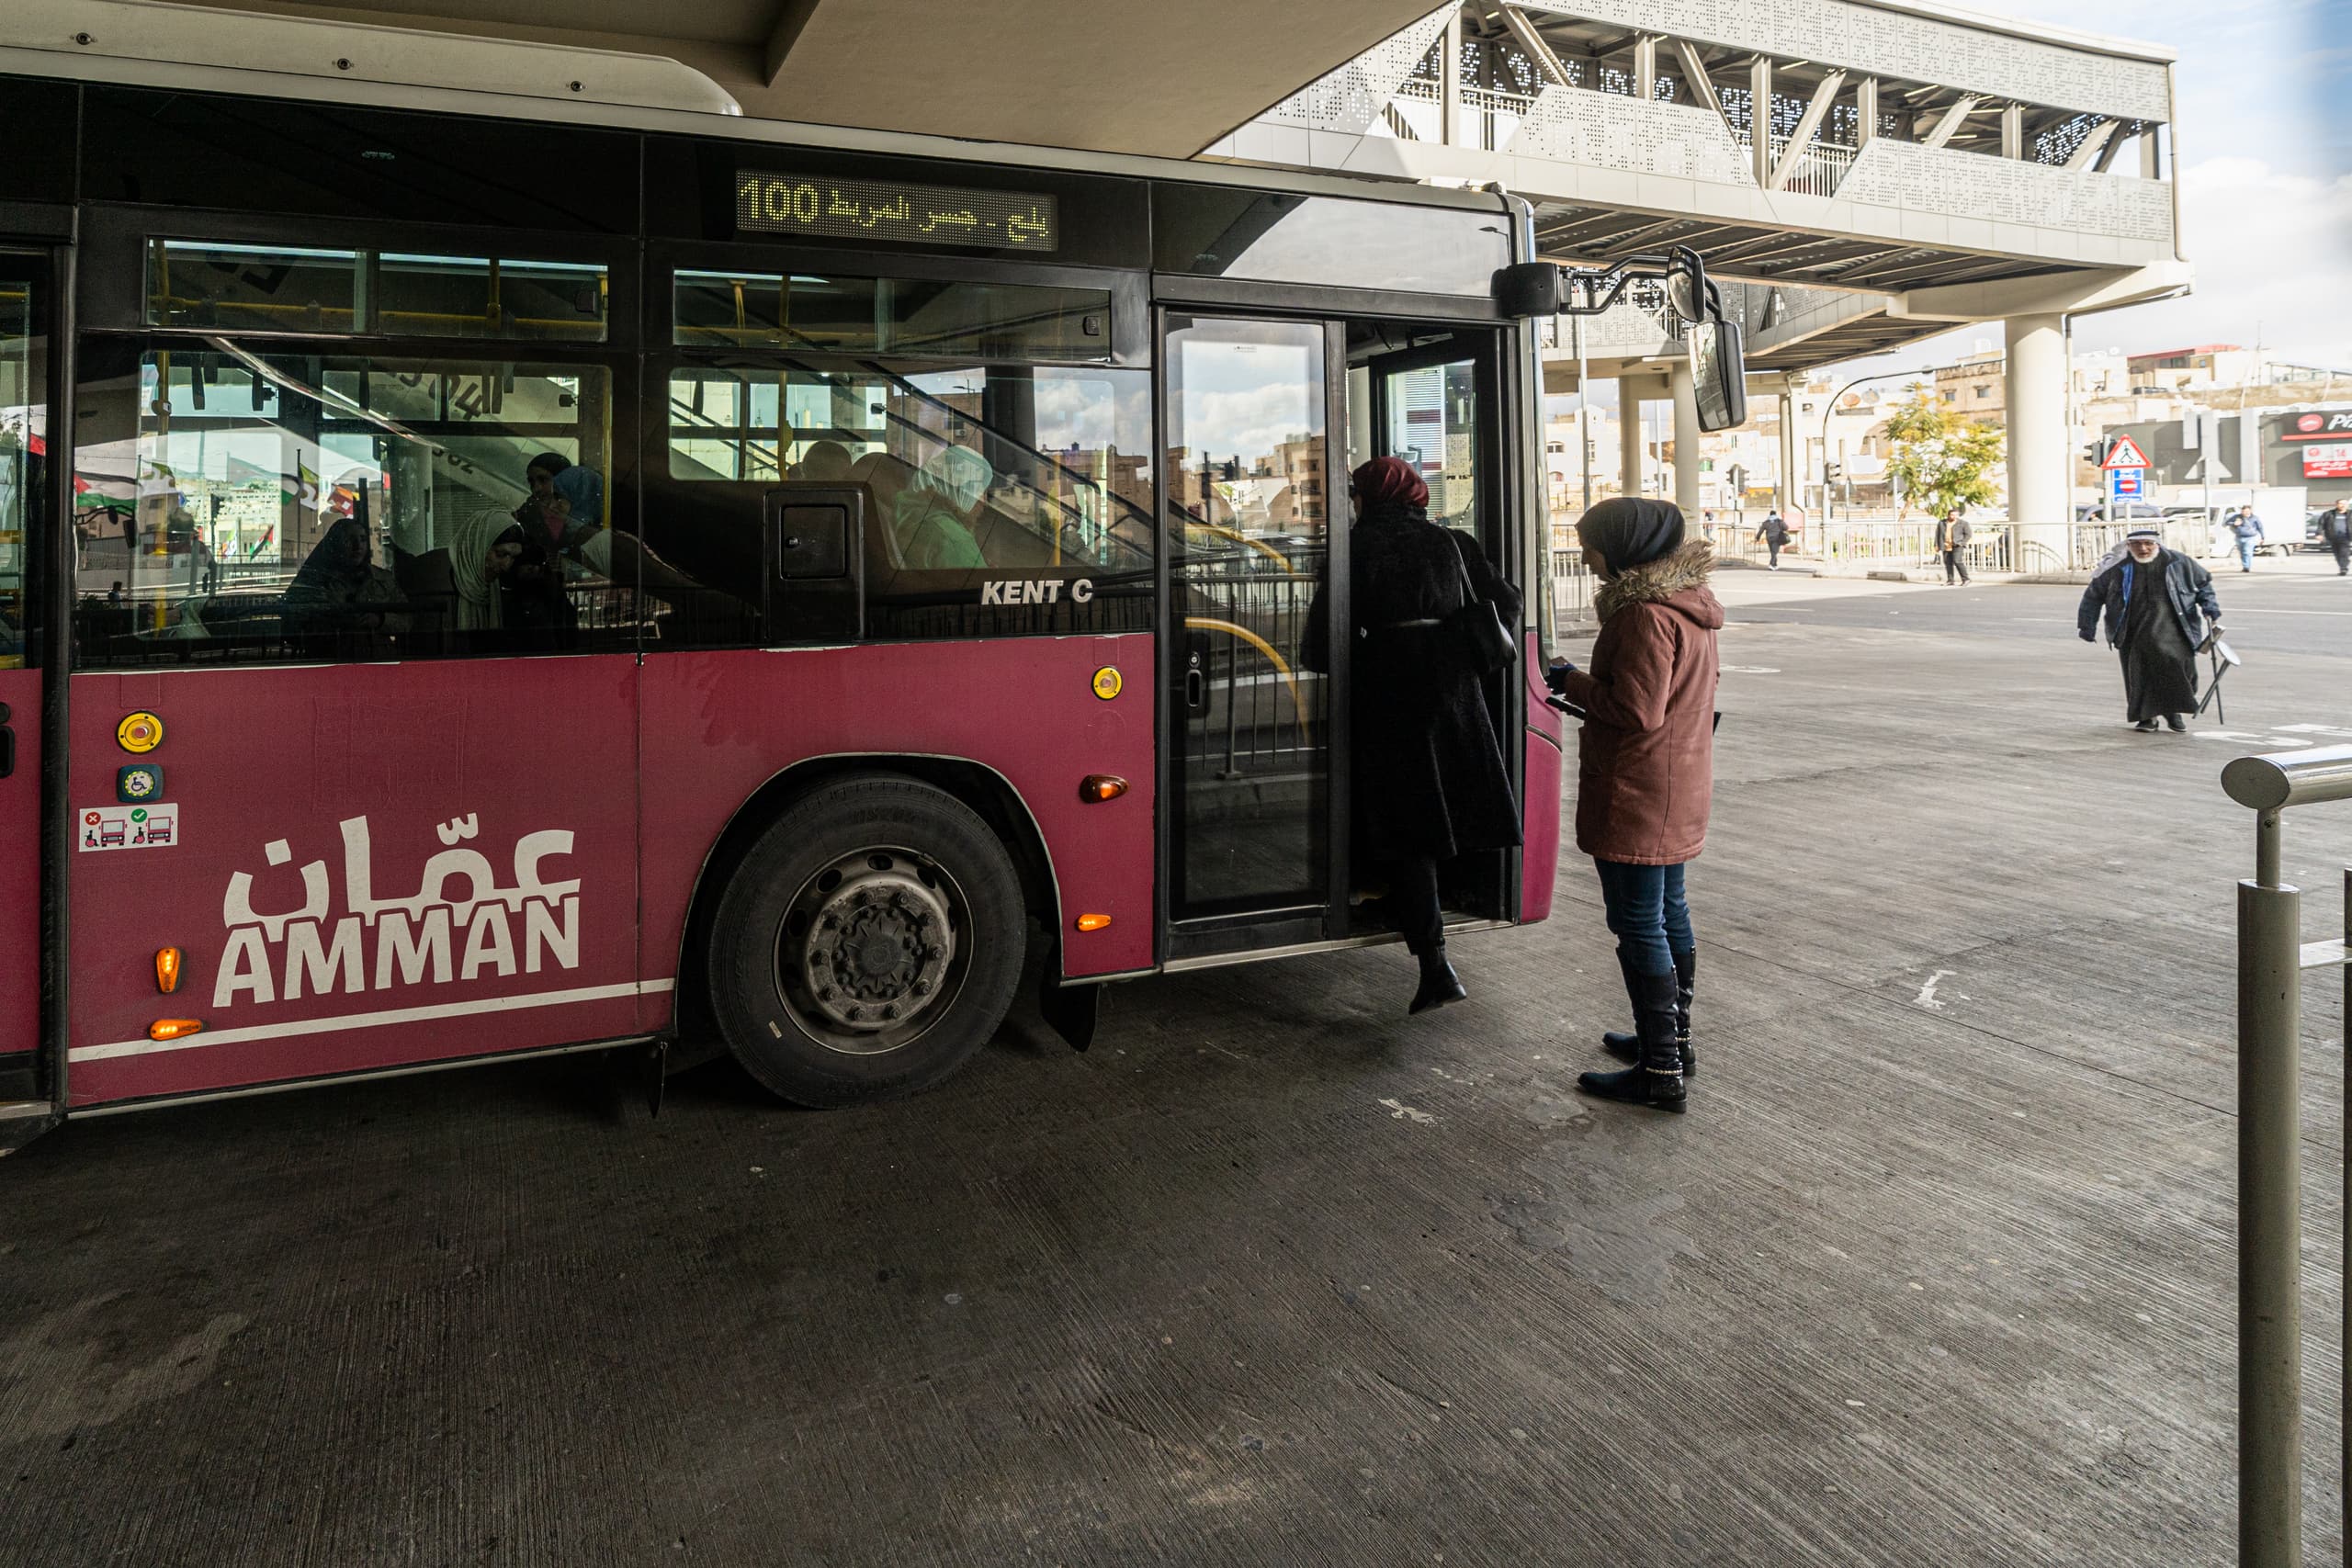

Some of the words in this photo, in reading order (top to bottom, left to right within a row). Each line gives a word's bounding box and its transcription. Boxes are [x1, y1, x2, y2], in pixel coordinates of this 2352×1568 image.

[740, 179, 819, 222] 100
[919, 210, 977, 231] جسر
[981, 580, 1064, 605] KENT
[1072, 579, 1093, 604] C
[212, 897, 580, 1008] AMMAN
